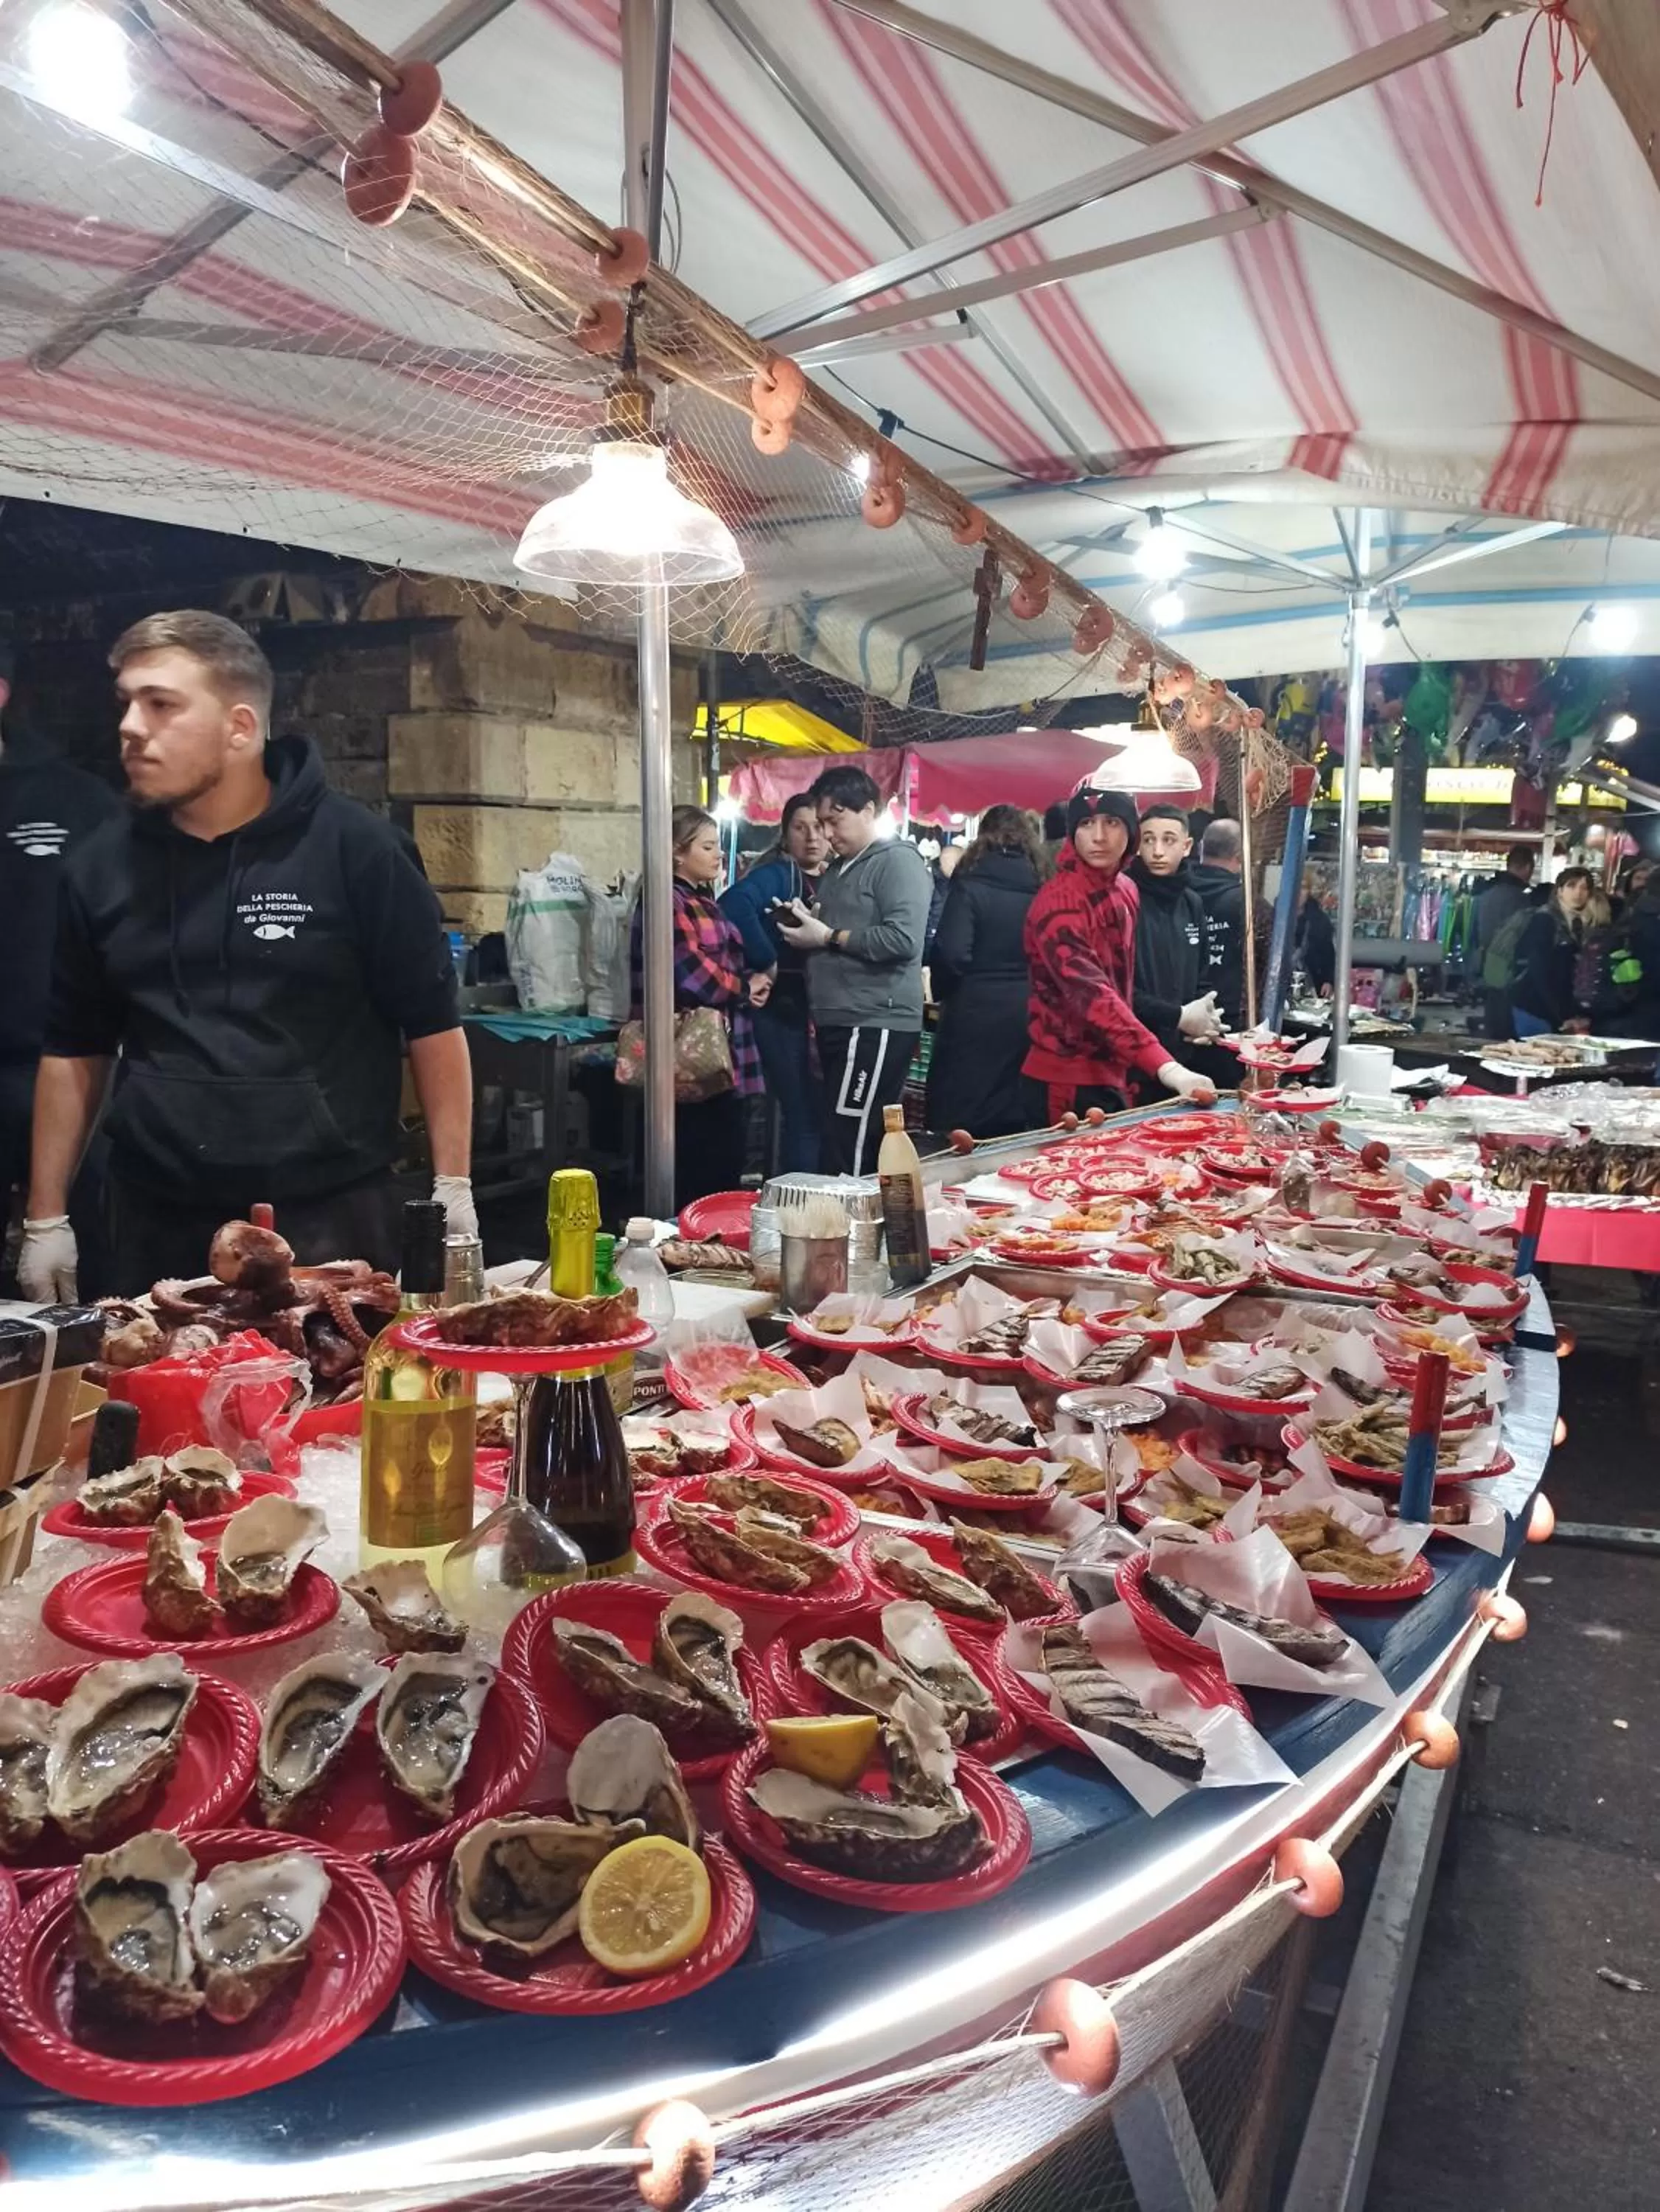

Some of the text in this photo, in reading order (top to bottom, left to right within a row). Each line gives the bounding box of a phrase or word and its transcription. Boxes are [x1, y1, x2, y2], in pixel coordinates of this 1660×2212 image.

[251, 894, 263, 902] LA
[237, 903, 313, 913] DELLA PESCHERIA
[244, 914, 306, 924] da Giovanni
